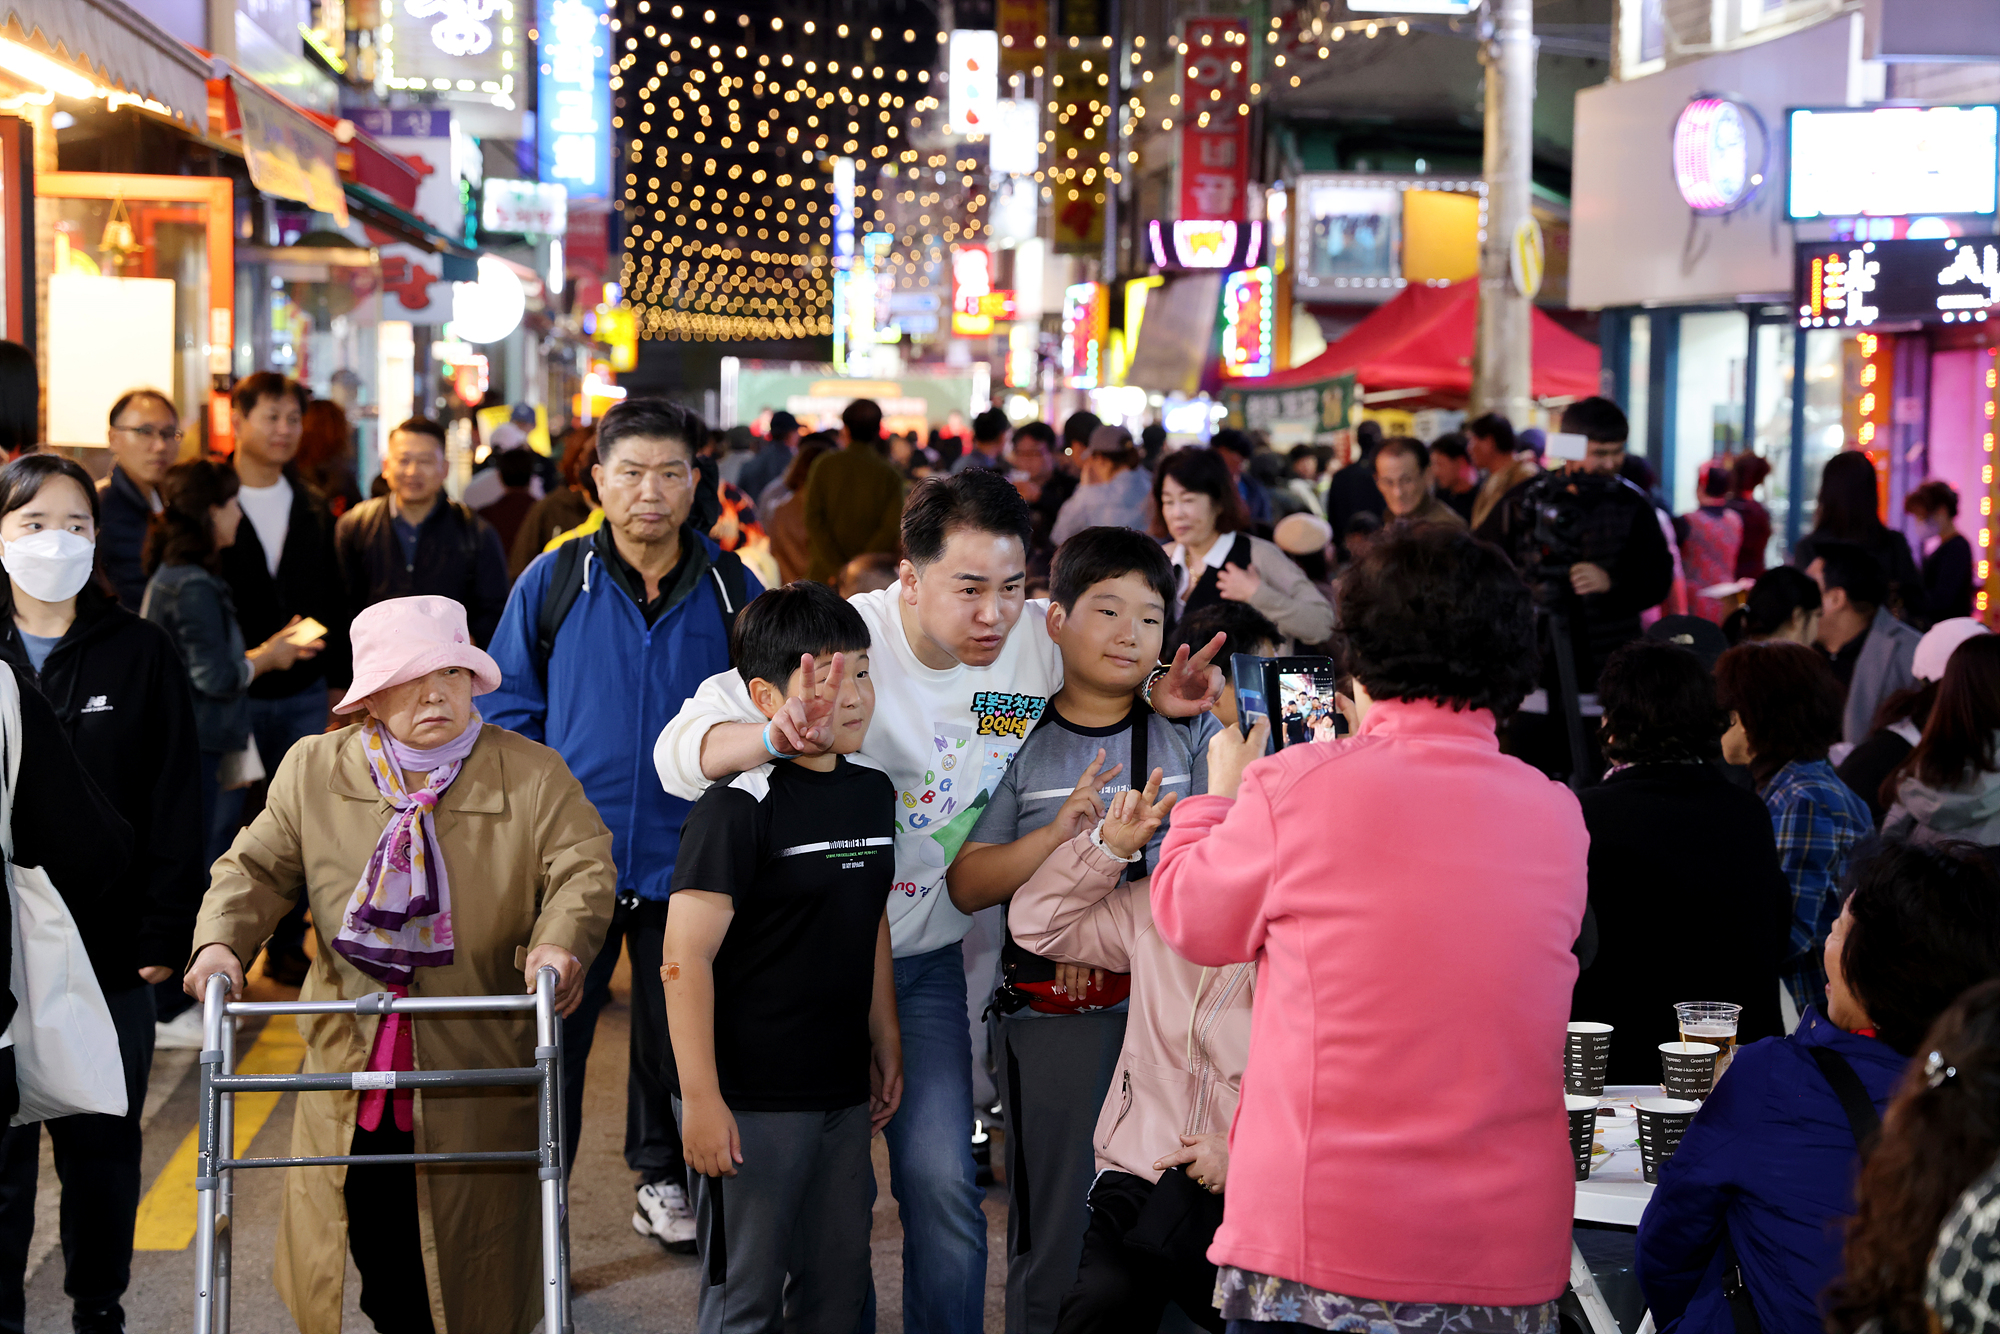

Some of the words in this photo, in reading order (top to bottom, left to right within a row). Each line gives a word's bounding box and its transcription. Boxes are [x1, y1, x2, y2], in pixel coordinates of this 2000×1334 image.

[971, 691, 1046, 719] 도봉구청장
[978, 714, 1028, 738] 오언석
[925, 770, 935, 785] D
[939, 778, 953, 792] G
[920, 790, 936, 804] B
[940, 797, 957, 814] N
[909, 813, 931, 829] G
